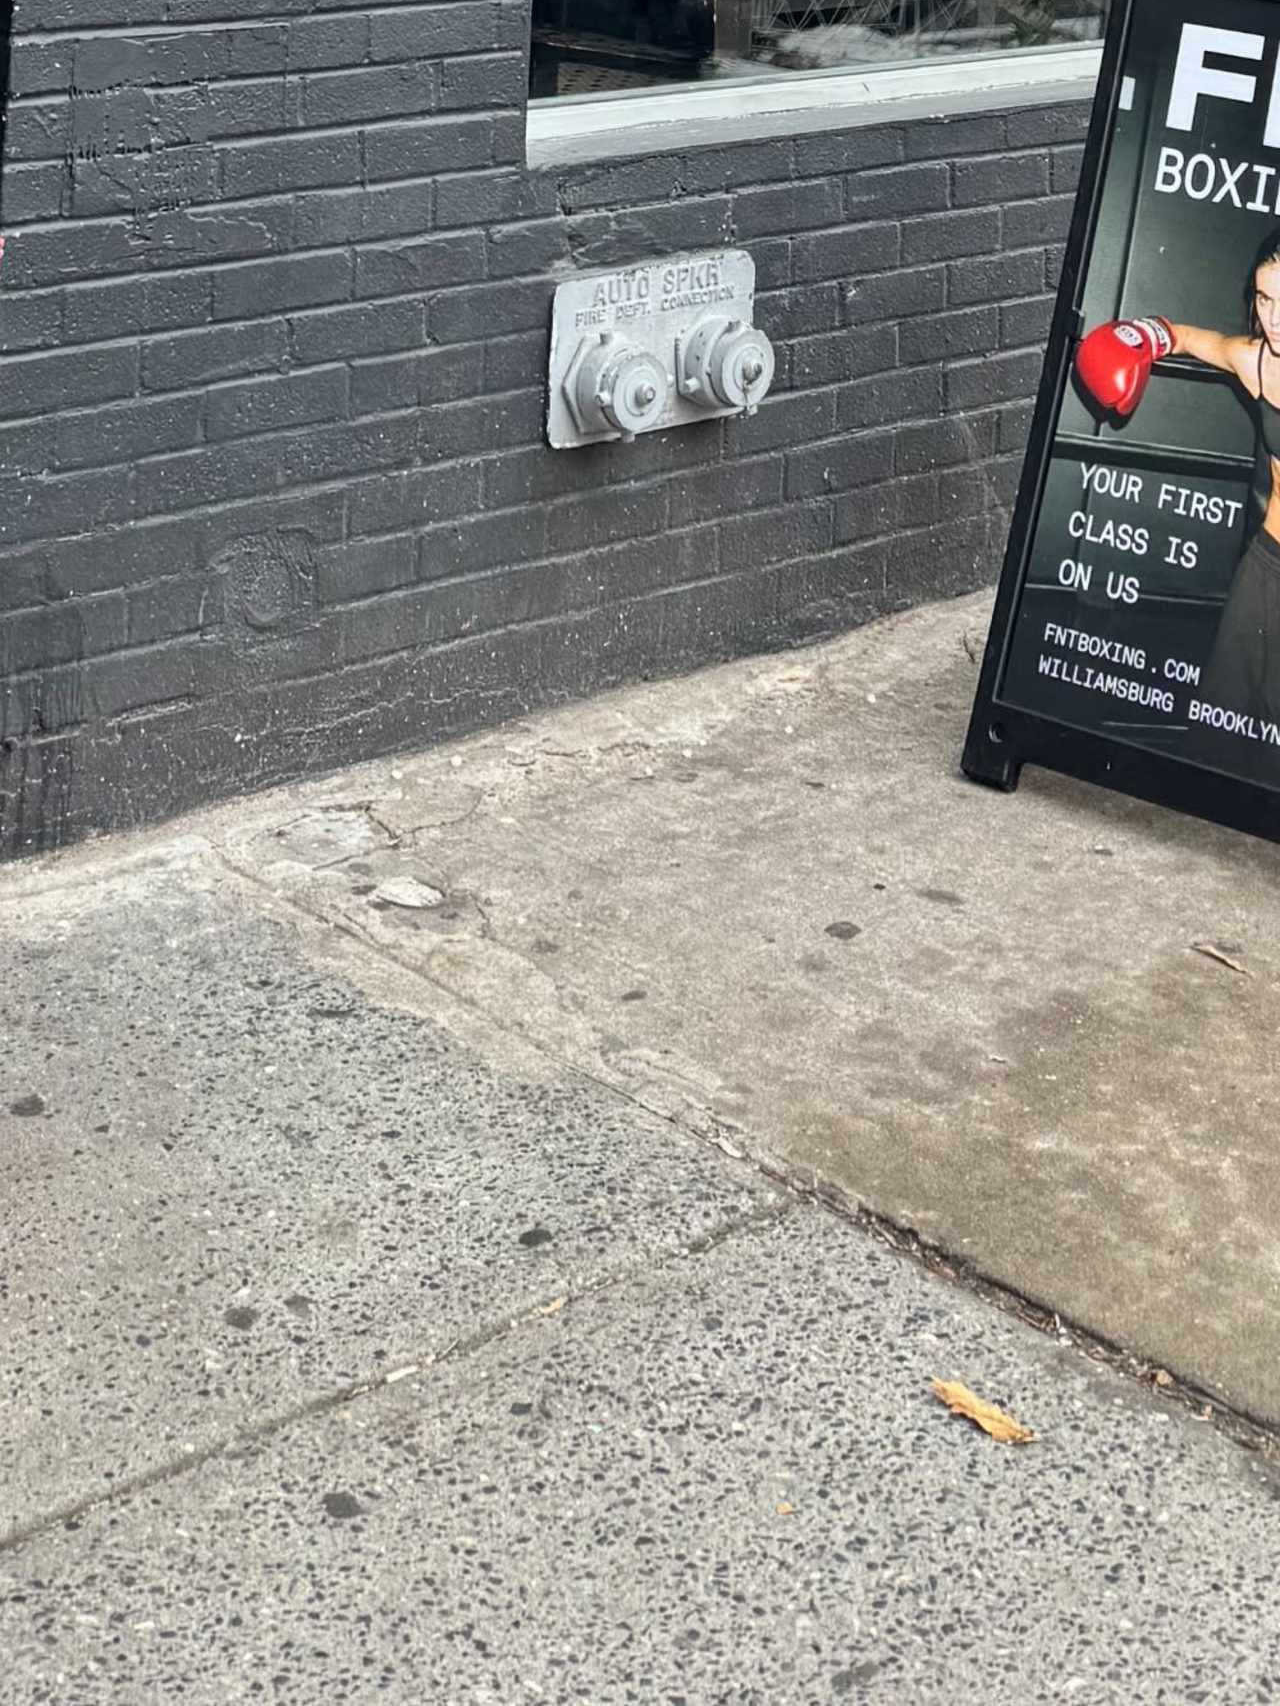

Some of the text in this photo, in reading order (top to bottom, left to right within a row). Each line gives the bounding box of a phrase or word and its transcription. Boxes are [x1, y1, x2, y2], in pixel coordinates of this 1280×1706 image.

[575, 307, 605, 328] FIRE
[660, 285, 735, 313] CONNECTION
[593, 260, 721, 308] AUTO SPKR
[1080, 461, 1244, 528] YOUR FIRST
[1068, 510, 1198, 569] CLASS IS
[1058, 558, 1140, 604] ON US
[1038, 654, 1174, 713] WILLIAMSBURG
[1044, 622, 1200, 686] FNTBOXING.COM
